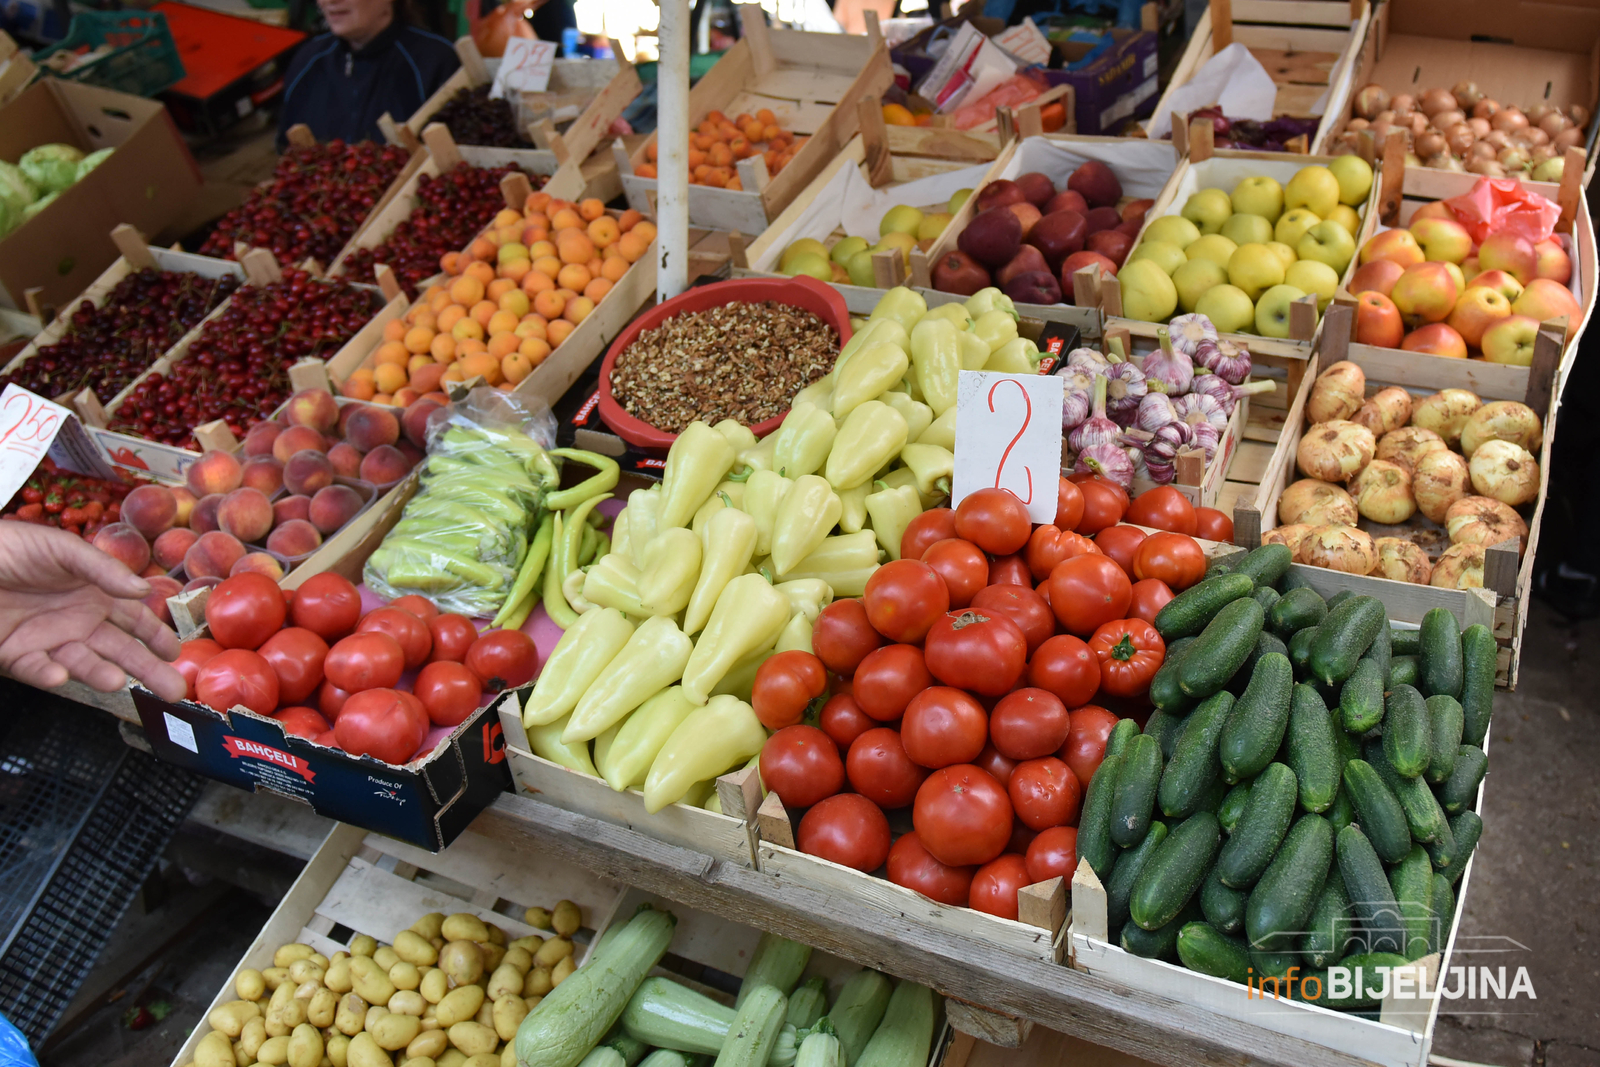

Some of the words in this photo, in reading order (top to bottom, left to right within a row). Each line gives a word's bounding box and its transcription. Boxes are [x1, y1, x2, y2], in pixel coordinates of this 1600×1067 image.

[987, 379, 1033, 505] 2
[234, 740, 297, 768] BAHÇELİ
[367, 775, 393, 788] Produce
